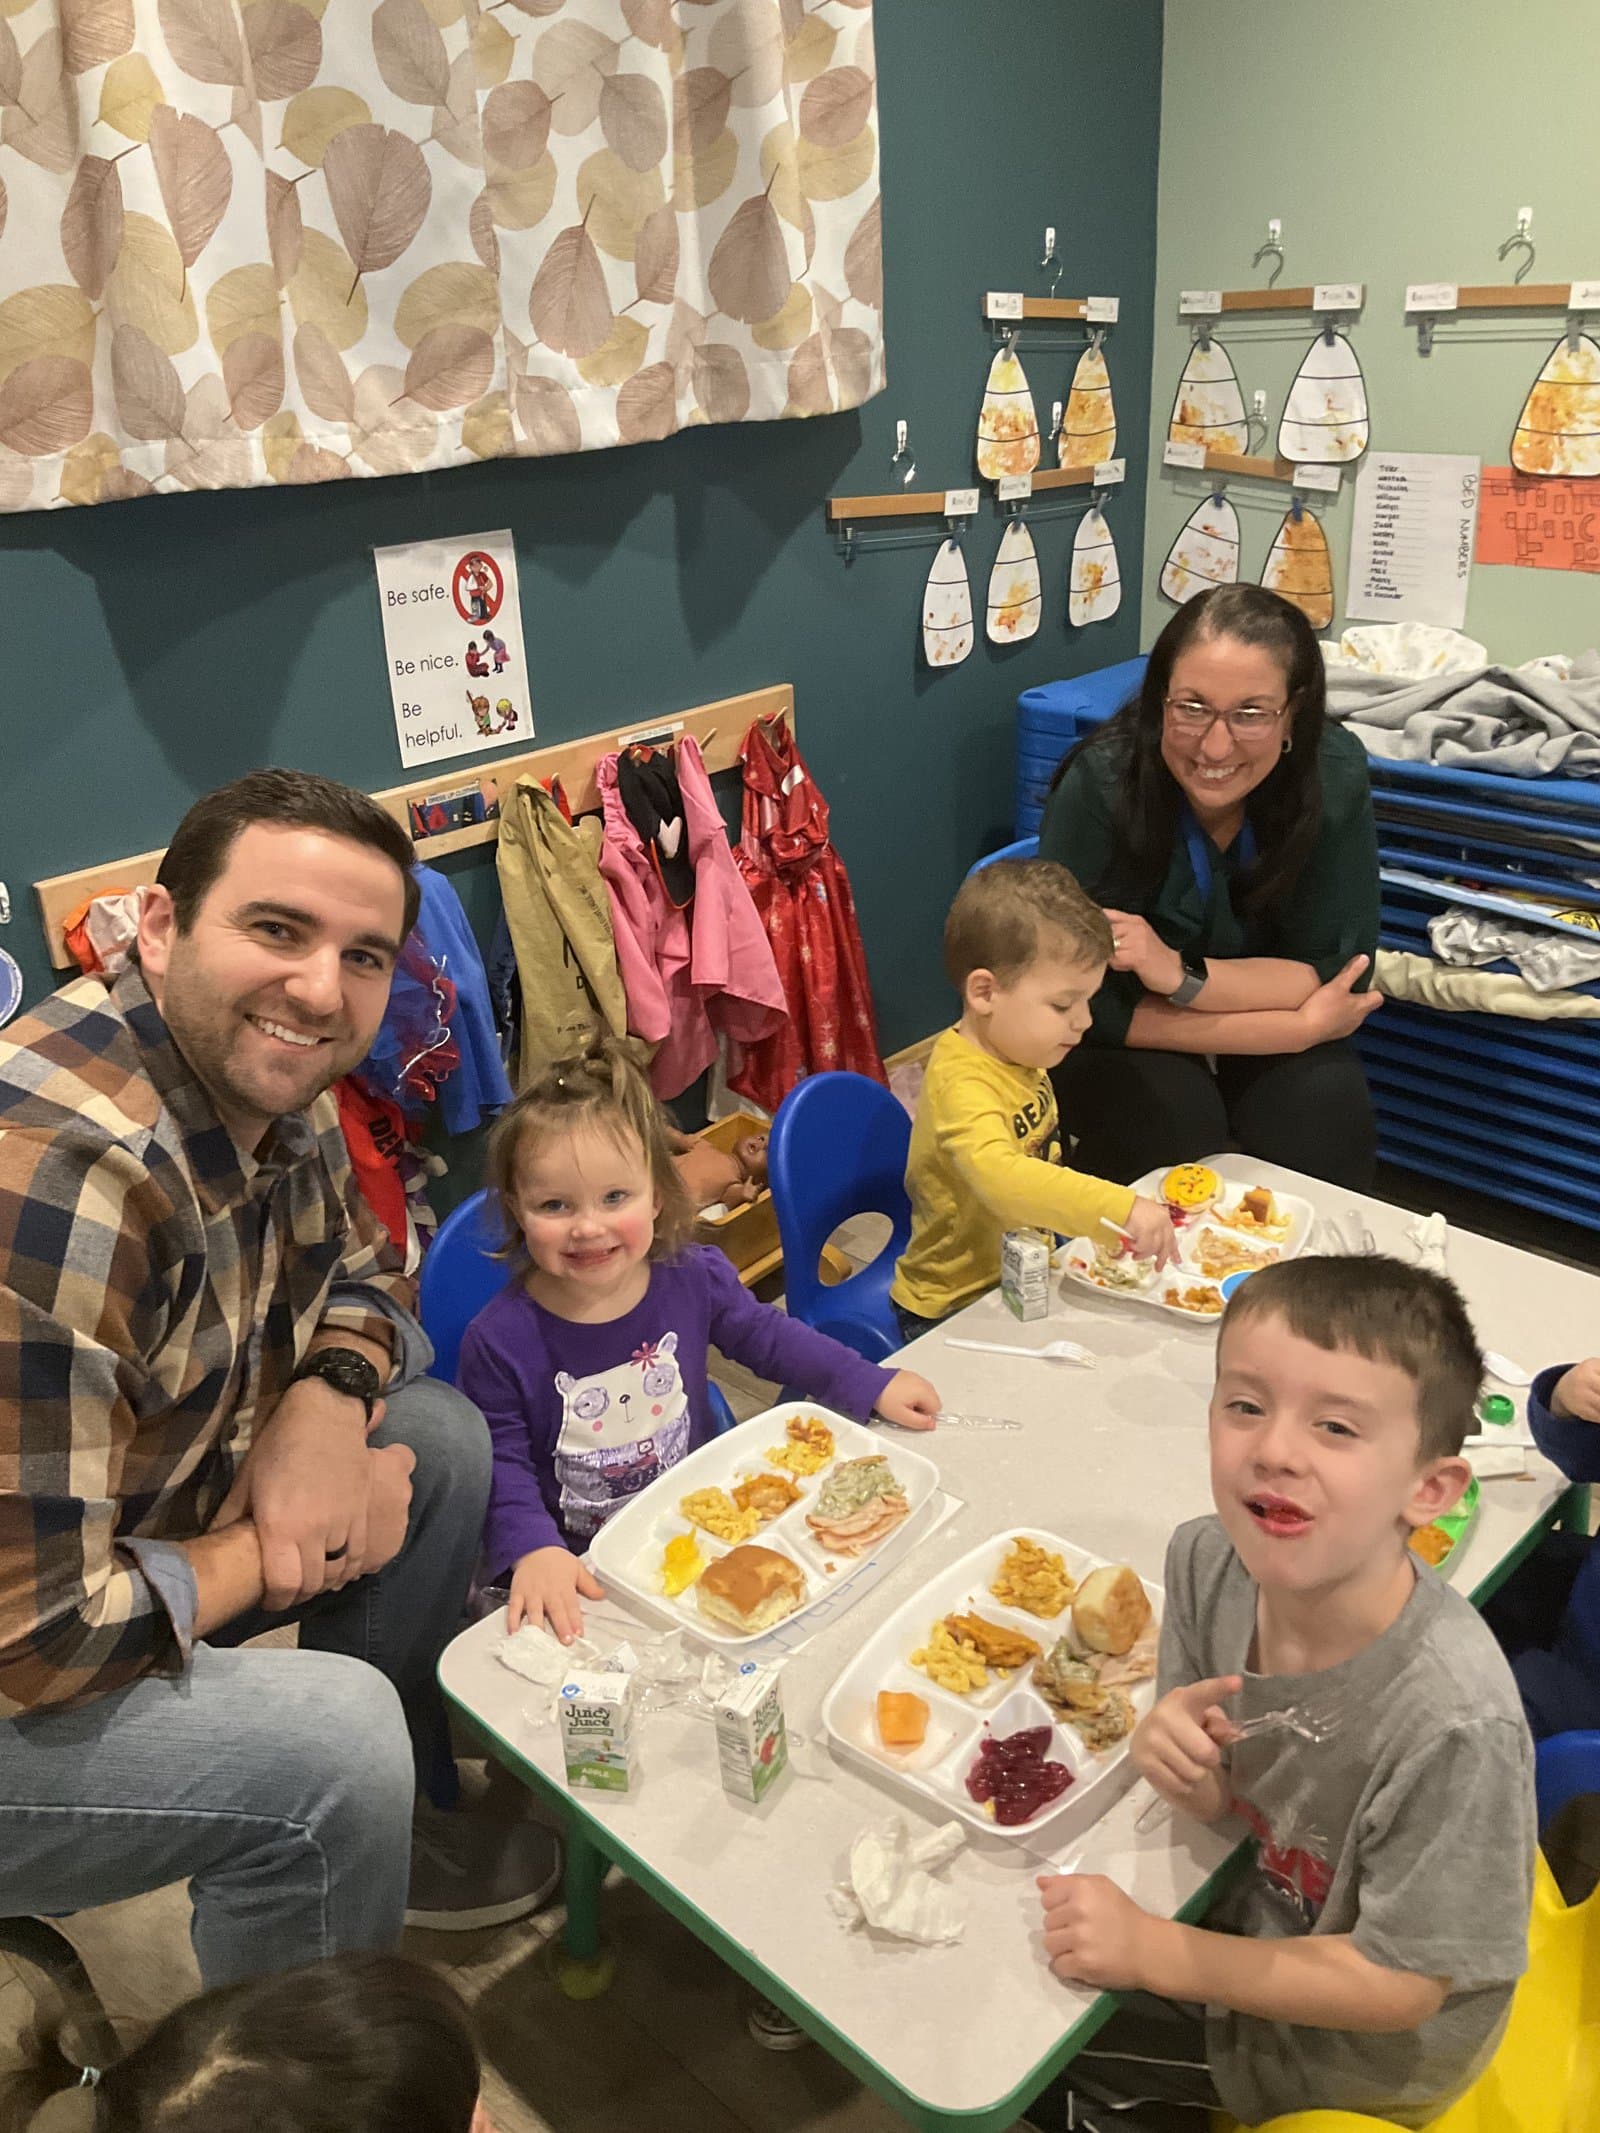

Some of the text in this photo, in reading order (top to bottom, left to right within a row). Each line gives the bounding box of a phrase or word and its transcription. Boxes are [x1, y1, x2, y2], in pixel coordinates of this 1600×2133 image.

[1457, 473, 1477, 579] BED NUMBERS
[387, 584, 450, 607] Be safe.
[395, 653, 460, 676] Be nice.
[401, 702, 422, 718] Be
[405, 725, 463, 749] helpful.
[565, 1704, 610, 1720] Juicy
[569, 1717, 610, 1728] Juice
